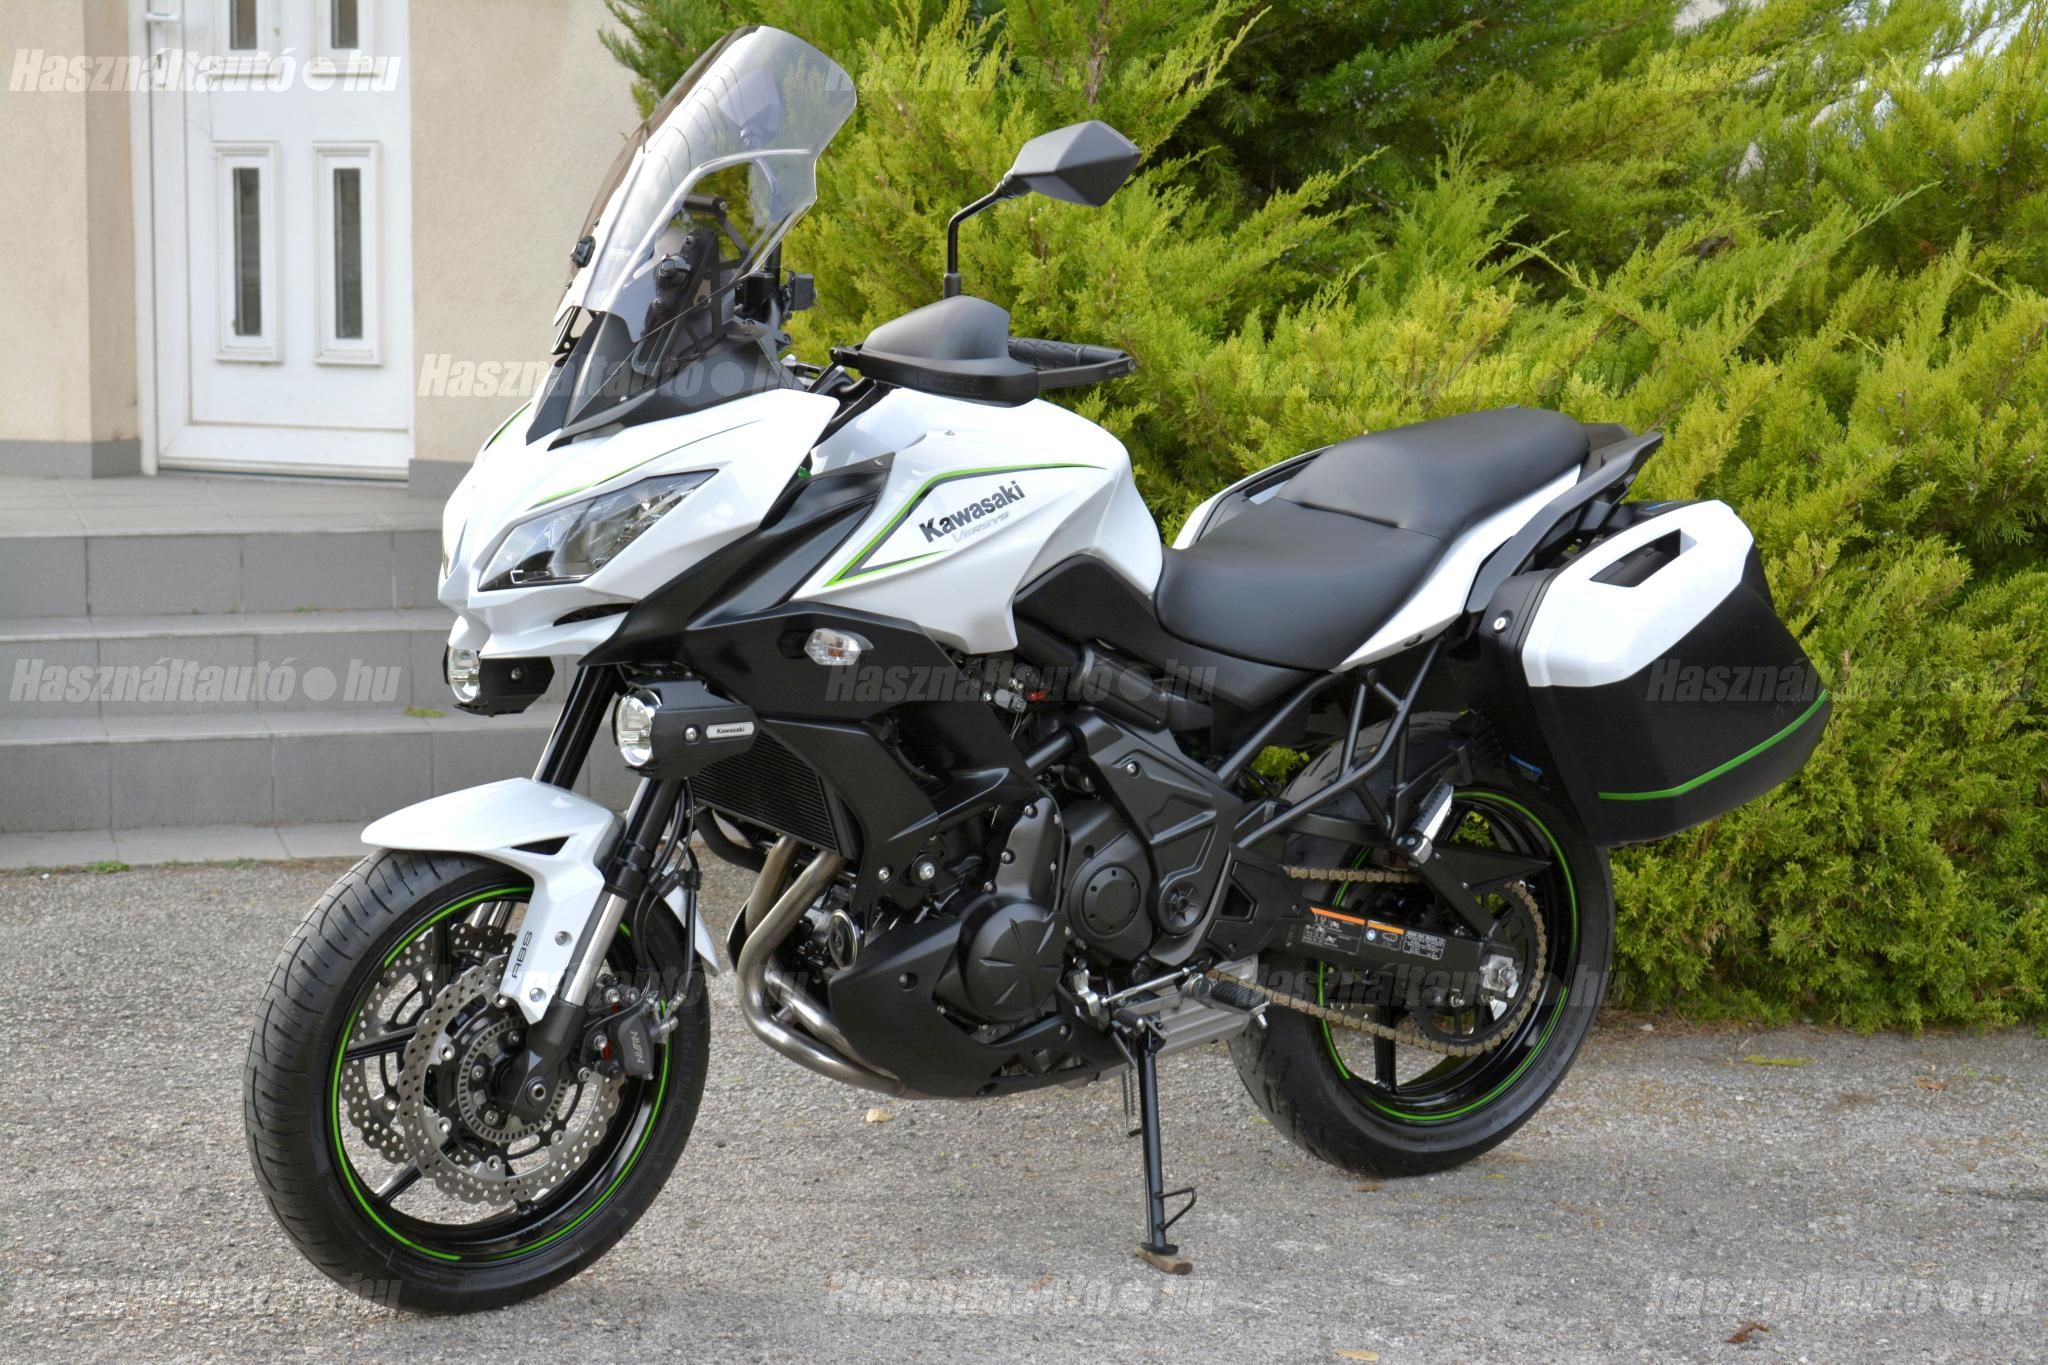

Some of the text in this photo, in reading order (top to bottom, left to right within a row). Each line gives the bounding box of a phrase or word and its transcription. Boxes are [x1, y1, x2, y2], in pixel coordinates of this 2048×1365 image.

[919, 480, 1026, 543] Kawasaki
[716, 726, 745, 735] Kawasaki
[511, 930, 533, 979] ABS
